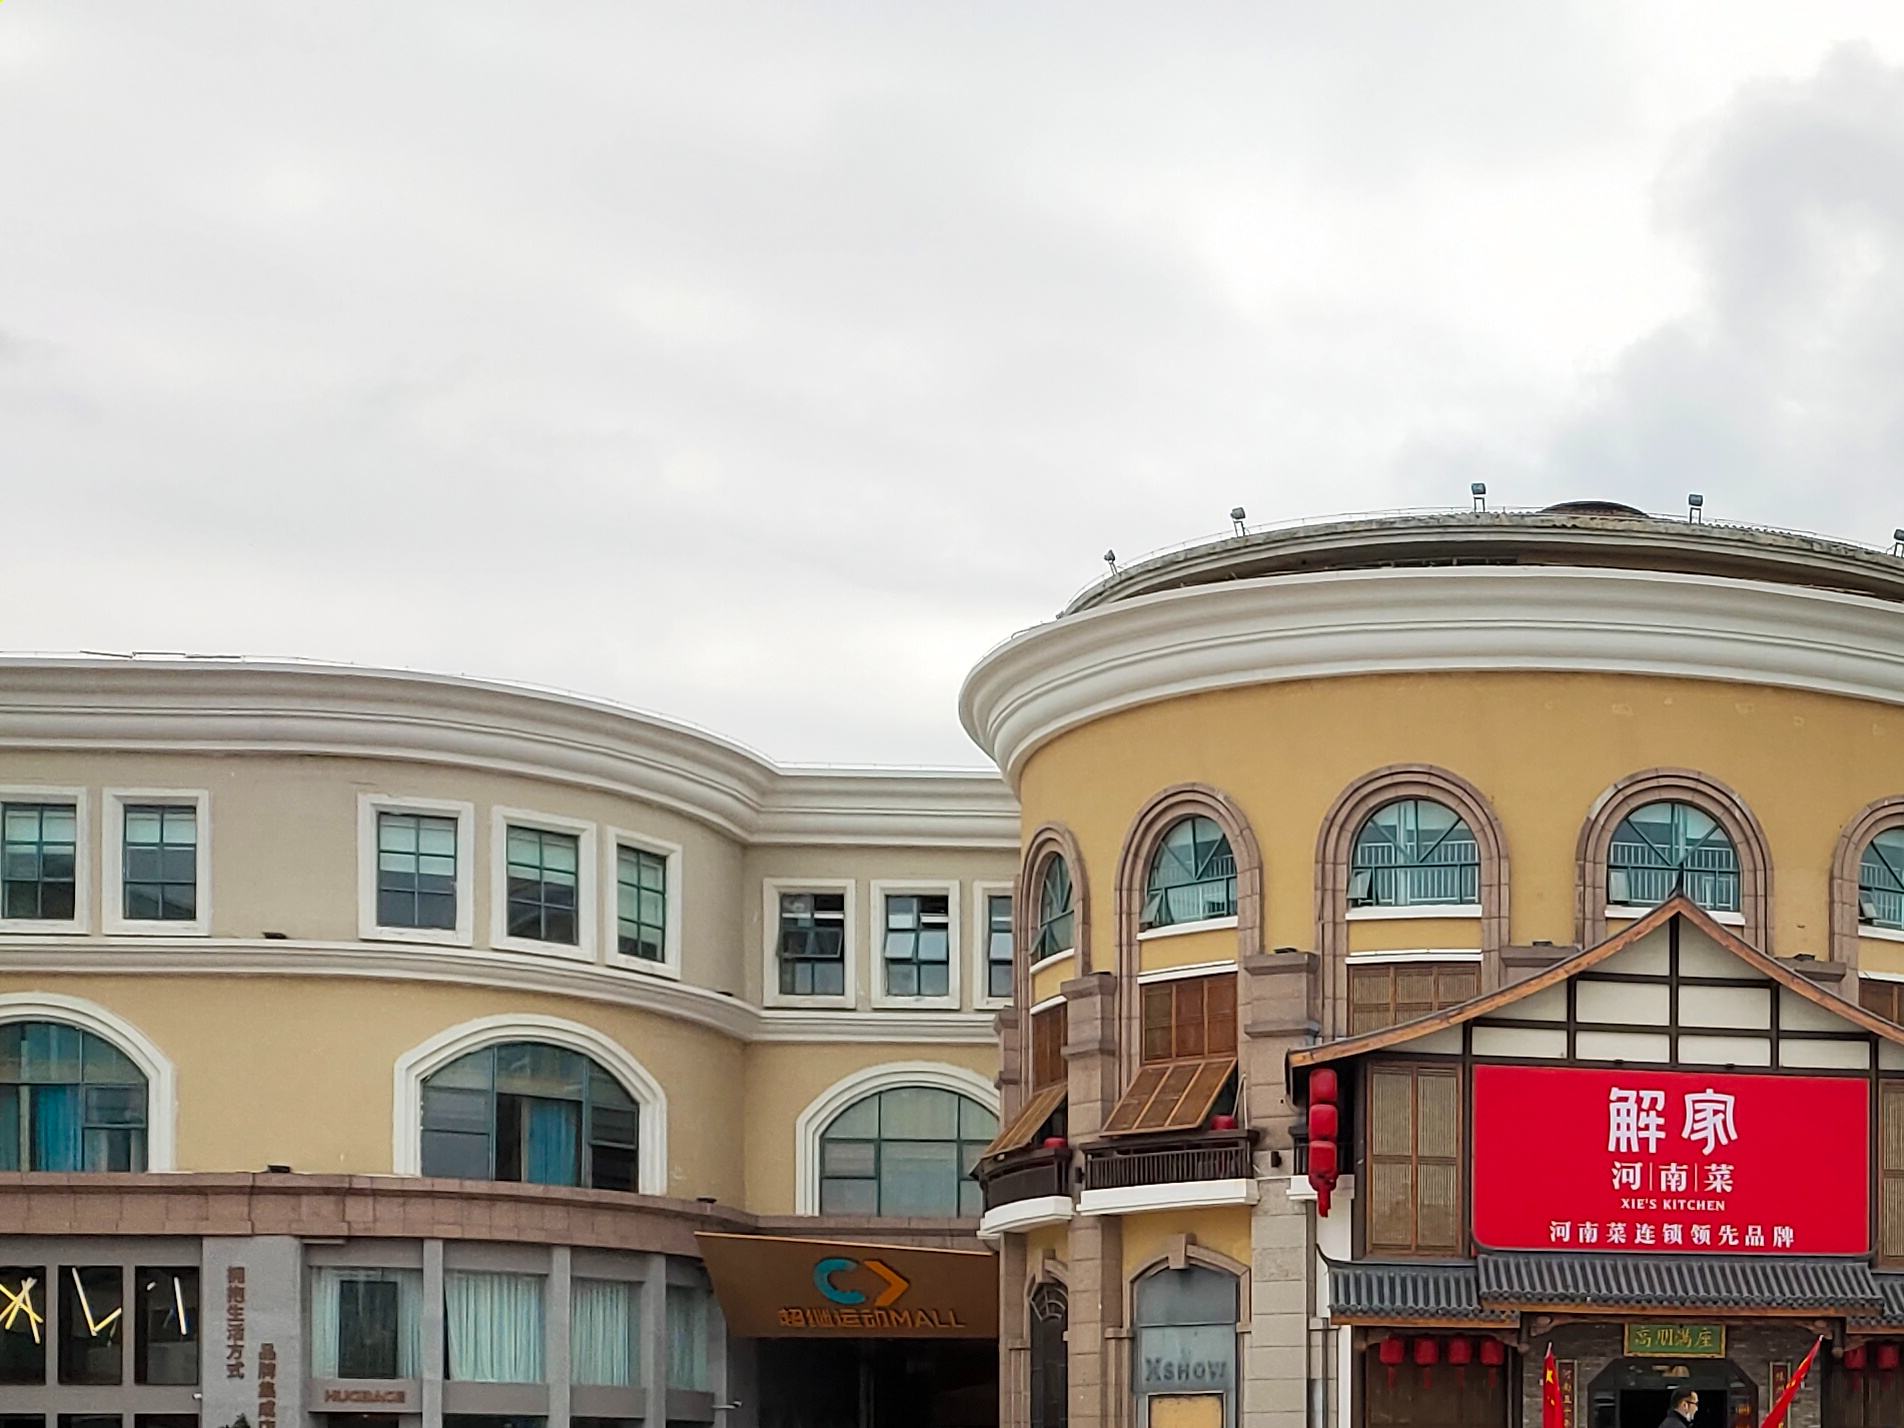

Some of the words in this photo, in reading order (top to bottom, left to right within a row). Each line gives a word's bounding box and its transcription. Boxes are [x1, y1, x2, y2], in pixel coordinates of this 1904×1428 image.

[1608, 1086, 1738, 1156] 解家
[1620, 1198, 1658, 1210] XIE'S
[1662, 1198, 1726, 1212] KITCHEN
[1549, 1220, 1796, 1248] 河南菜连锁领先品牌
